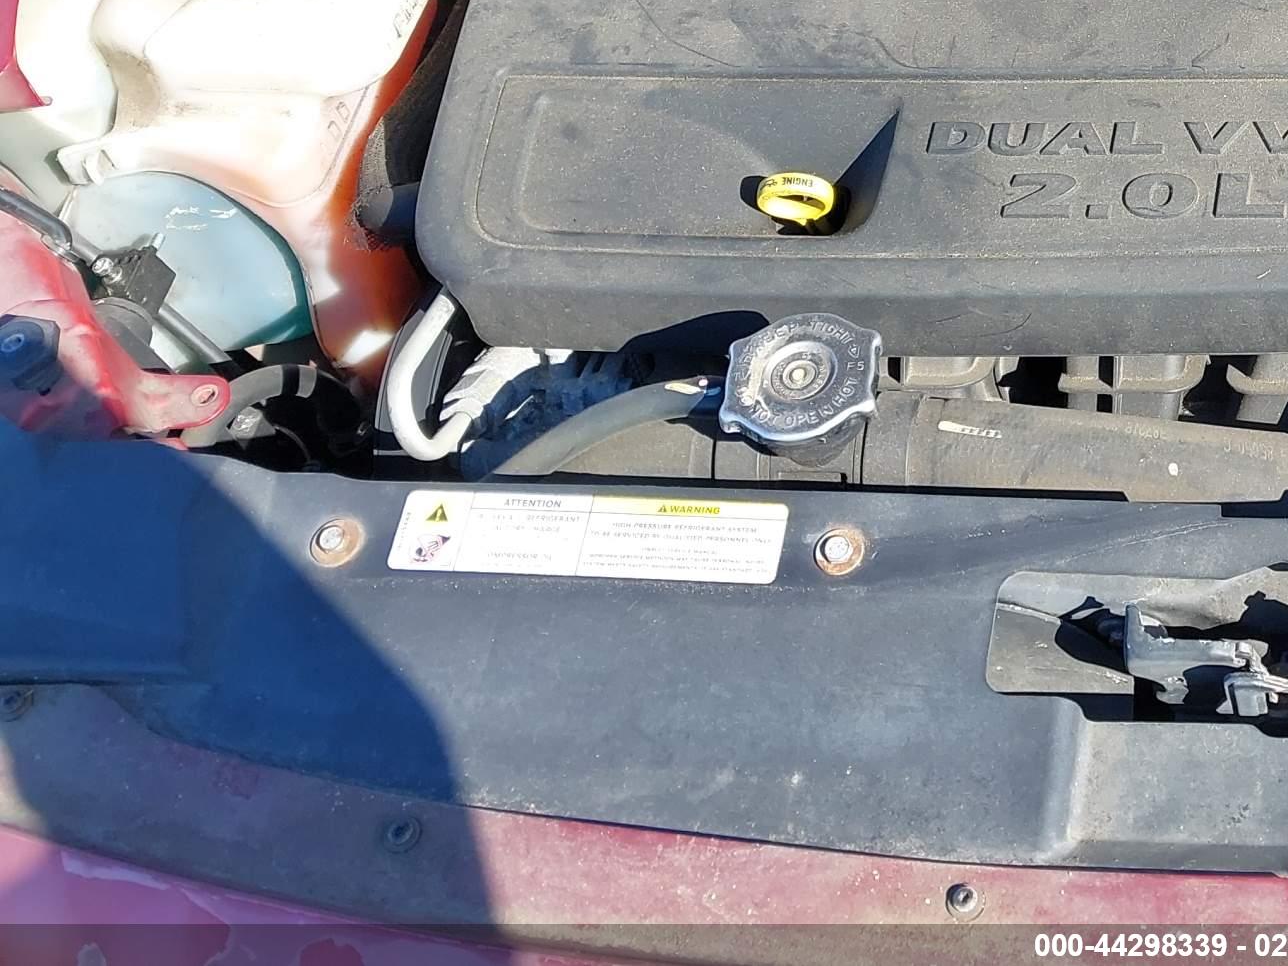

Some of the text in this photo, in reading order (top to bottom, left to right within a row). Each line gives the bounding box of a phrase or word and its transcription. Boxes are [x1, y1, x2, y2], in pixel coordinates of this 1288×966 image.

[925, 120, 1163, 156] DUAL
[781, 176, 814, 187] ENGINE
[810, 320, 857, 346] TIGHT
[784, 402, 835, 426] OPEN
[831, 377, 858, 408] HOT
[504, 498, 562, 508] ATTENTION
[669, 505, 721, 515] WARNING
